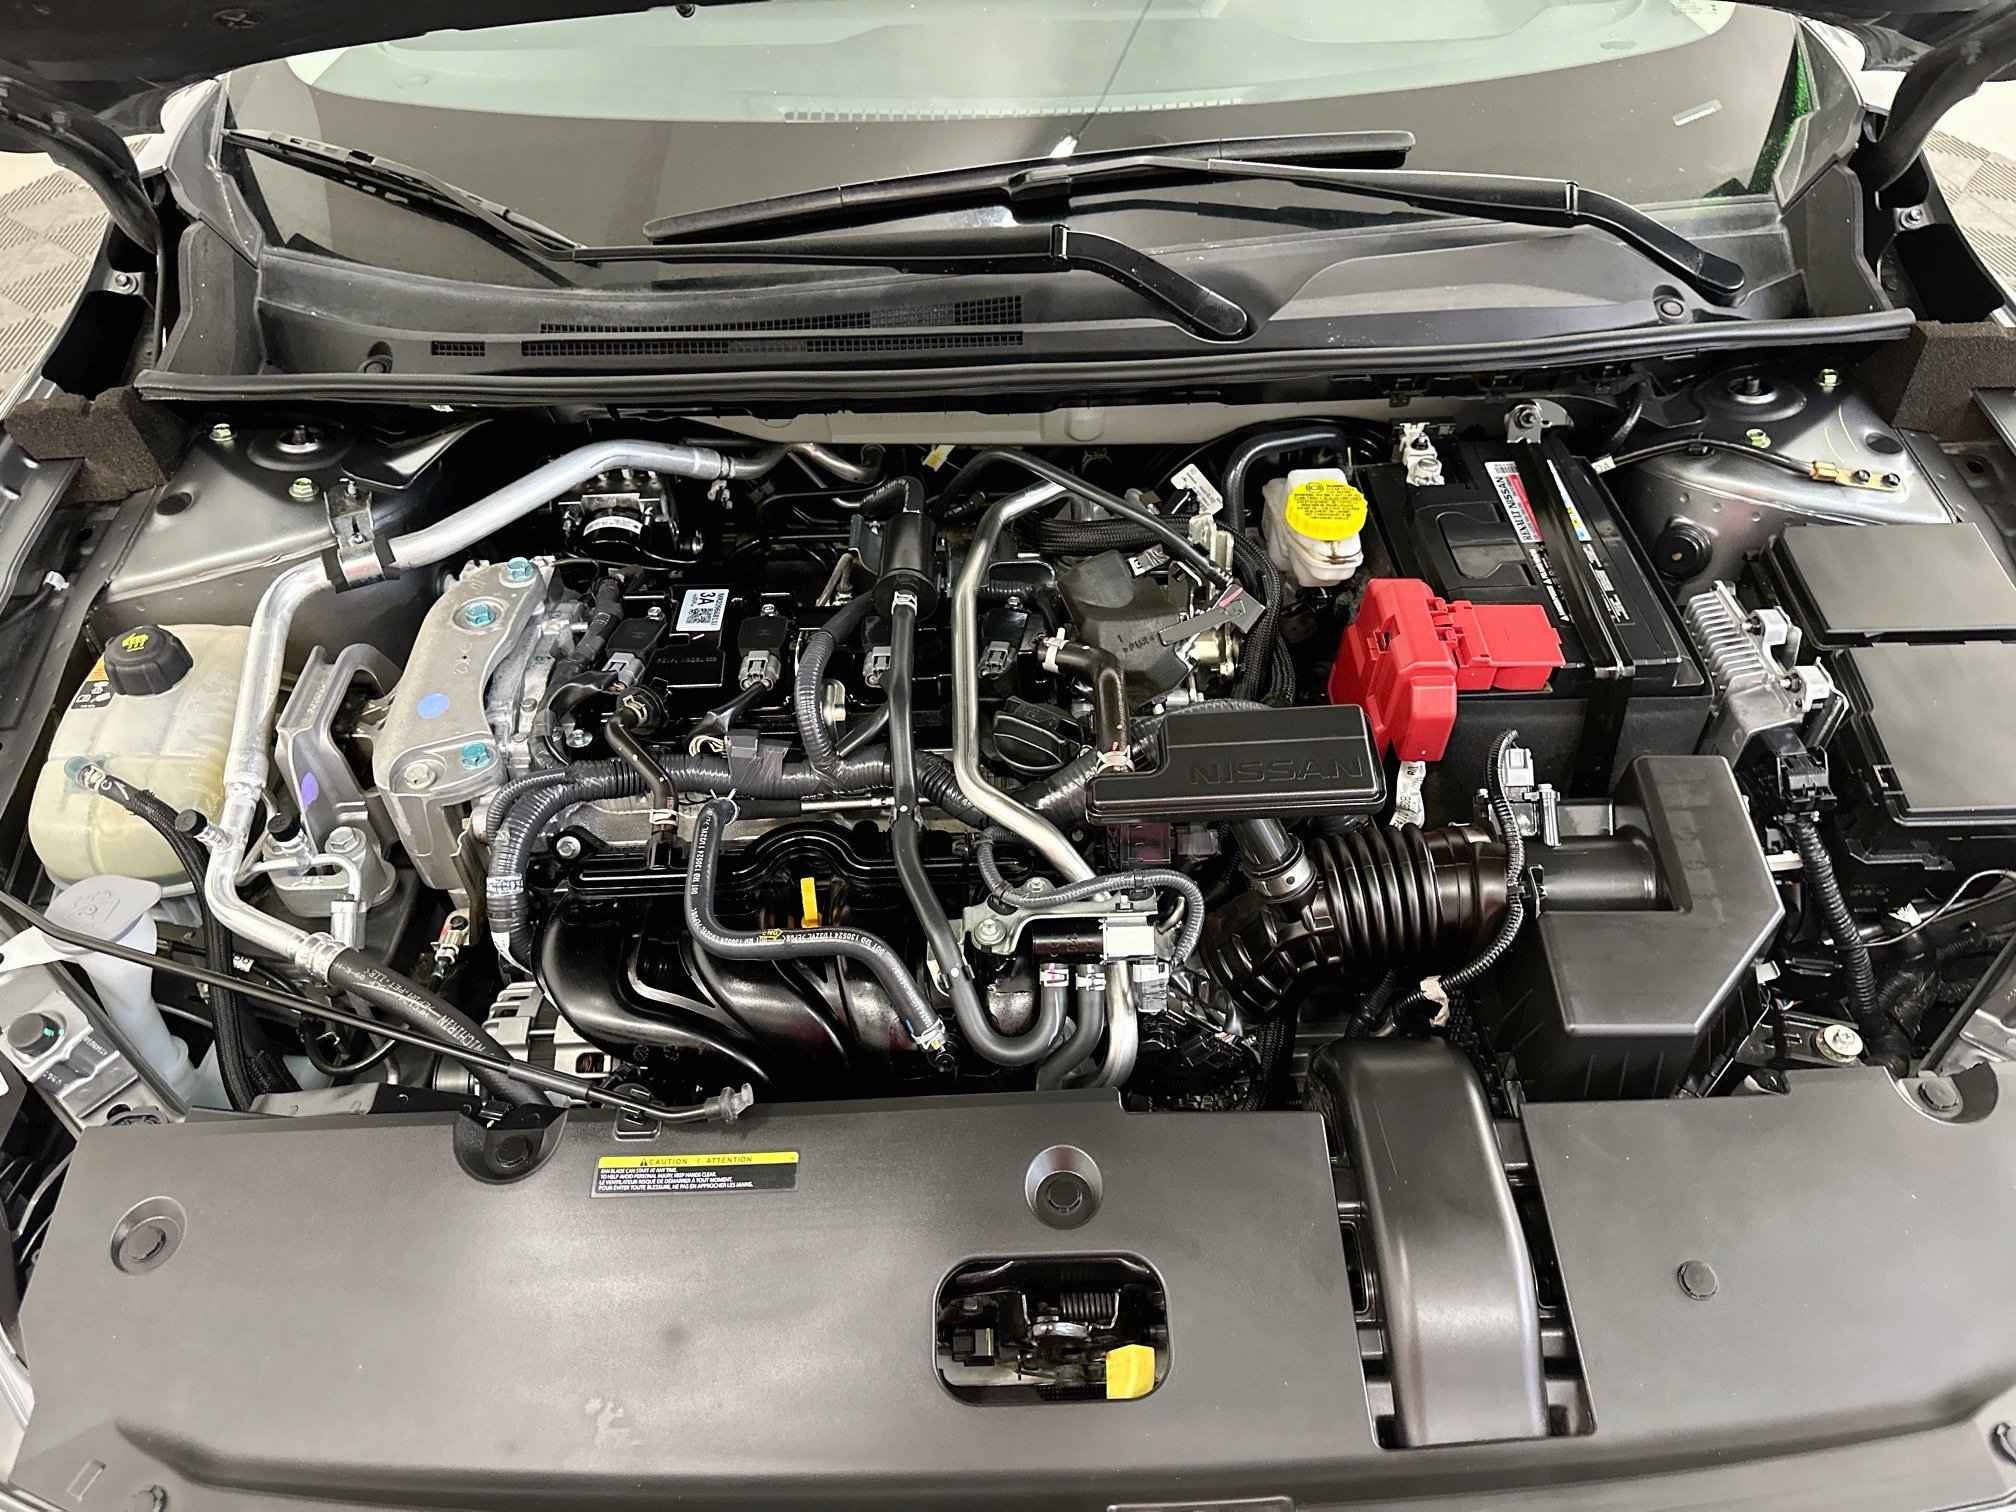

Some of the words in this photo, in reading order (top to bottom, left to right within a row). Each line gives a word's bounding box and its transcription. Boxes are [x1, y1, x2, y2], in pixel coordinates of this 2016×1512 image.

[1495, 476, 1517, 509] NISSAN
[1511, 510, 1533, 541] RENAULT
[697, 592, 716, 606] 3A
[1190, 755, 1364, 785] NISSAN
[436, 1014, 486, 1052] NICHIRIN
[649, 1158, 688, 1166] CAUTION
[706, 1156, 753, 1164] ATTENTION
